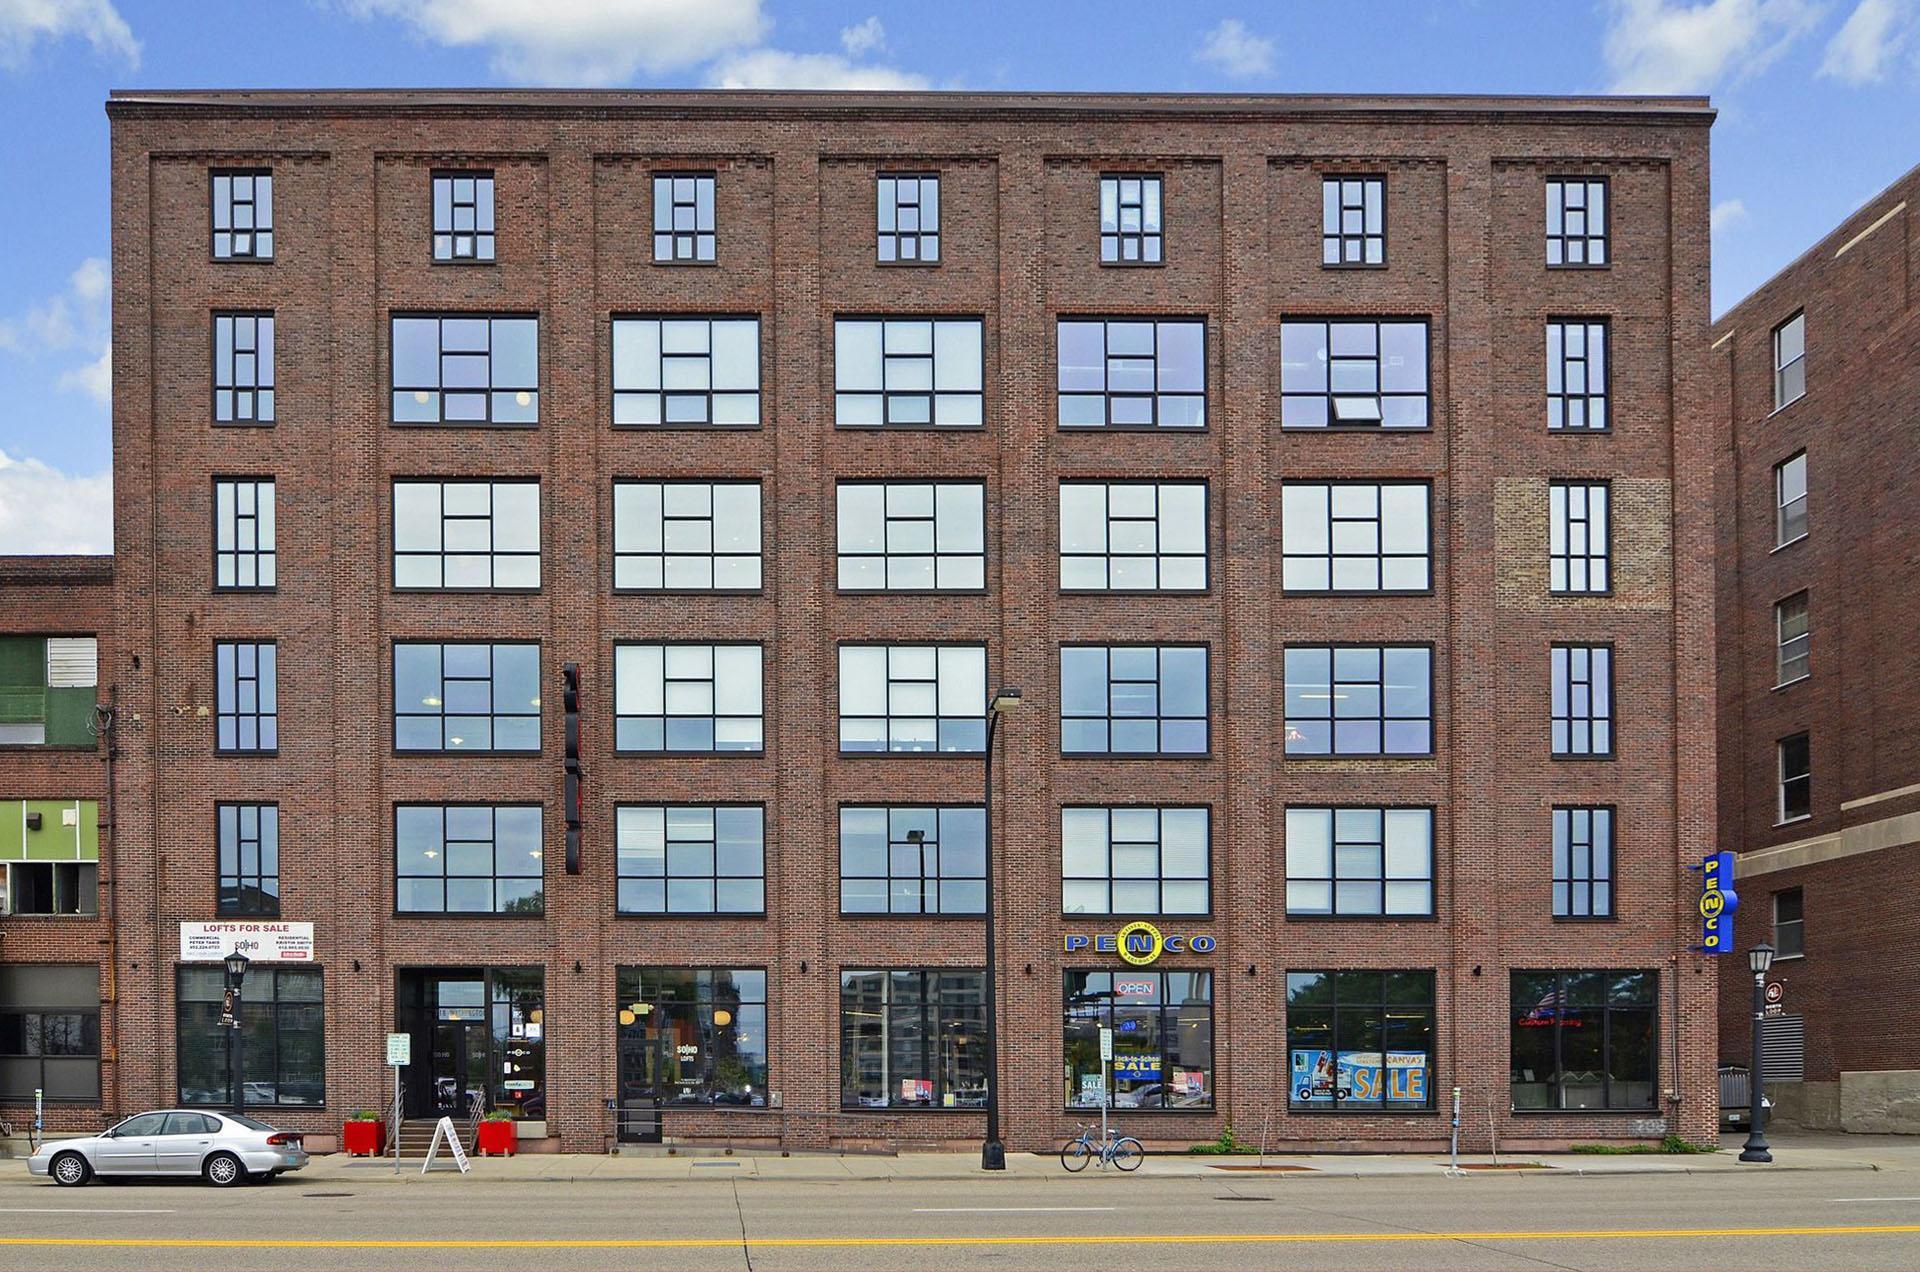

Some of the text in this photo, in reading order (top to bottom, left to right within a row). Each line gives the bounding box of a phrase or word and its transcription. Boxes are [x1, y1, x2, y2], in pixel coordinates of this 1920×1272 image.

[1704, 861, 1719, 947] PENCO
[203, 924, 290, 933] LOFTS FOR SALE
[1064, 934, 1216, 953] PENCO
[1119, 984, 1153, 993] OPEN
[1114, 1062, 1161, 1071] SALE
[1081, 1081, 1102, 1090] SALE
[1354, 1069, 1423, 1098] SALE
